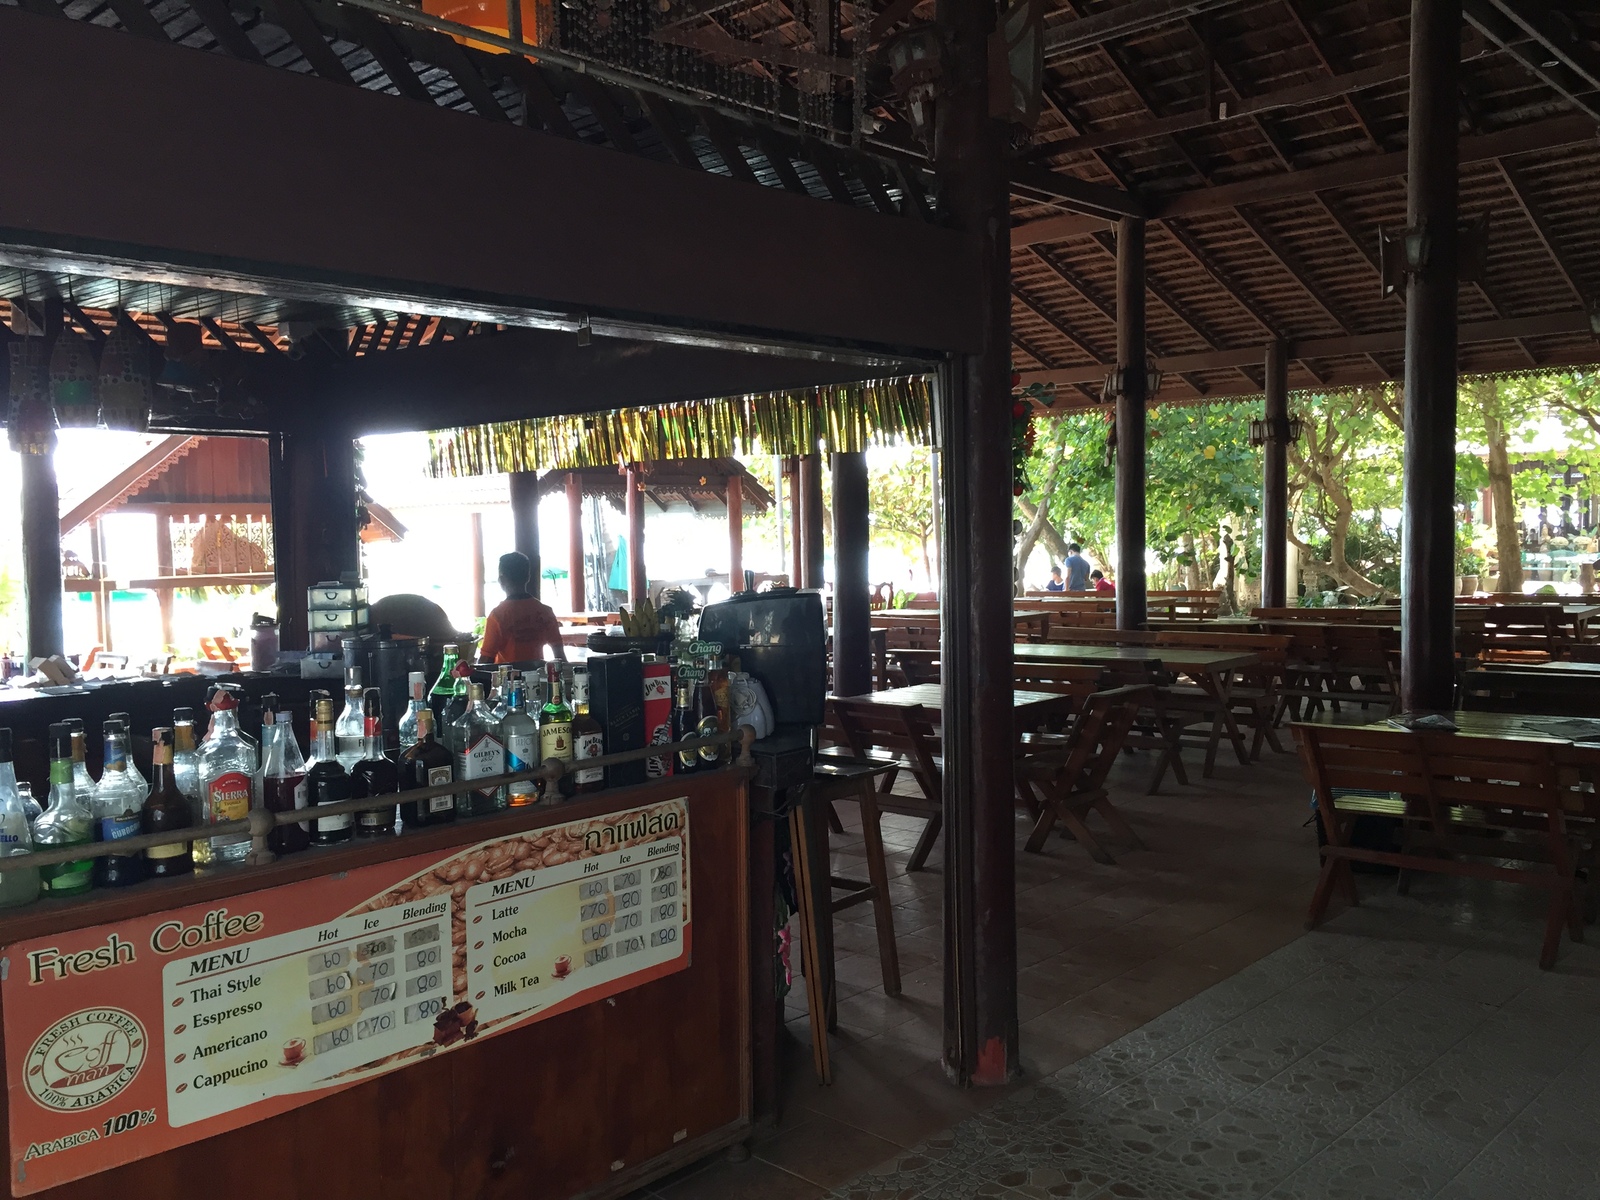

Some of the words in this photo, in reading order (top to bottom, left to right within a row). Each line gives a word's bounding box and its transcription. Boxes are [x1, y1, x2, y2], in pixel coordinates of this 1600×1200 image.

[689, 640, 722, 655] Chang
[678, 666, 706, 680] Chang
[213, 789, 249, 802] SIERRA
[585, 812, 679, 850] กาแฟสด
[583, 862, 599, 874] Hot
[619, 854, 631, 864] Ice
[647, 842, 680, 858] Blending
[491, 875, 536, 898] MENU
[589, 882, 603, 897] 60
[622, 872, 635, 885] 70
[590, 902, 607, 918] 70
[622, 890, 640, 908] 80
[659, 882, 676, 899] 90
[318, 927, 339, 942] Hot
[363, 918, 380, 930] Ice
[402, 901, 447, 920] Blending
[491, 903, 519, 921] Latte
[592, 923, 607, 941] 60
[622, 913, 638, 928] 70
[659, 903, 675, 920] 80
[28, 933, 135, 986] Fresh
[151, 907, 265, 955] Coffee
[492, 925, 528, 943] Mocha
[595, 946, 608, 962] 60
[624, 938, 639, 952] 70
[659, 928, 676, 944] 80
[189, 947, 251, 977] MENU
[324, 952, 341, 968] 60
[327, 975, 346, 994] 60
[369, 962, 389, 979] 70
[417, 950, 437, 967] 80
[493, 949, 527, 968] Cocoa
[190, 983, 223, 1004] Thai
[226, 974, 262, 998] Style
[328, 1000, 346, 1018] 60
[371, 987, 390, 1006] 70
[417, 975, 437, 993] 80
[493, 980, 518, 998] Milk
[520, 974, 540, 992] Tea
[192, 1000, 263, 1029] Esspresso
[332, 1027, 349, 1046] 60
[370, 1015, 391, 1033] 70
[419, 1000, 440, 1018] 80
[35, 1017, 80, 1057] FRESH
[86, 1012, 138, 1037] COFFEE
[192, 1028, 268, 1060] Americano
[38, 1088, 69, 1108] 100%
[70, 1064, 138, 1108] ARABICA
[66, 1065, 109, 1086] man
[192, 1057, 269, 1090] Cappucino
[24, 1128, 100, 1160] ARABICA
[103, 1108, 156, 1137] 100%
